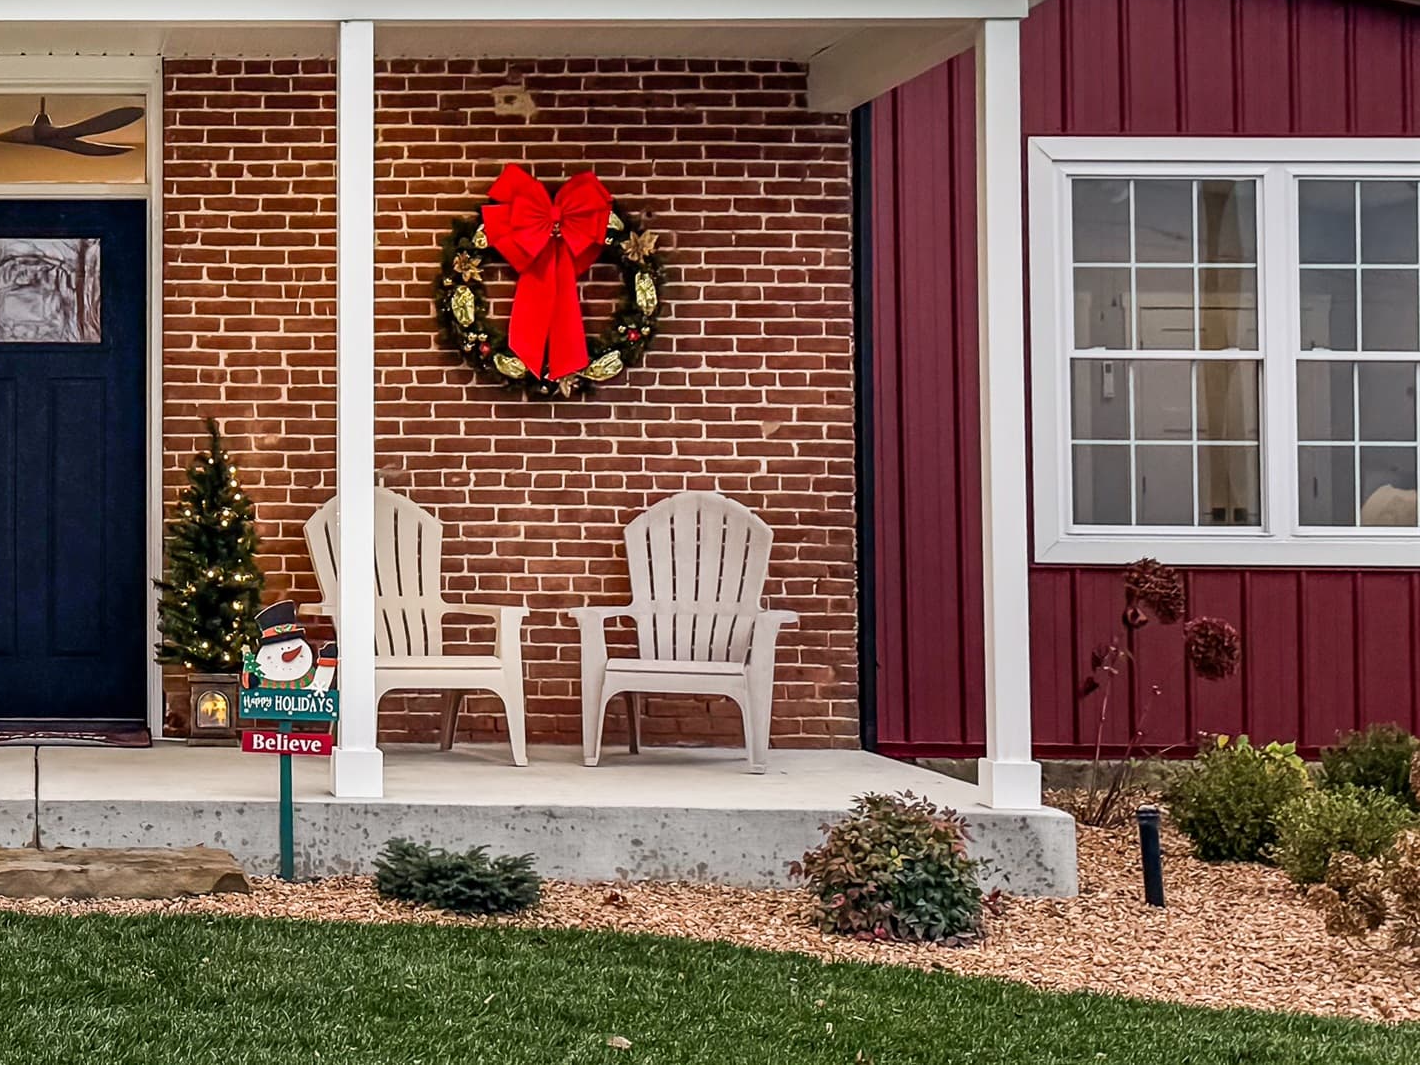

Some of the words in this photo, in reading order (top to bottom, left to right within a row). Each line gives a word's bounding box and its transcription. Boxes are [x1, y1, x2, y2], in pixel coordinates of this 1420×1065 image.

[243, 695, 272, 708] Happy
[275, 695, 334, 713] HOLIDAYS
[252, 733, 322, 752] Believe
